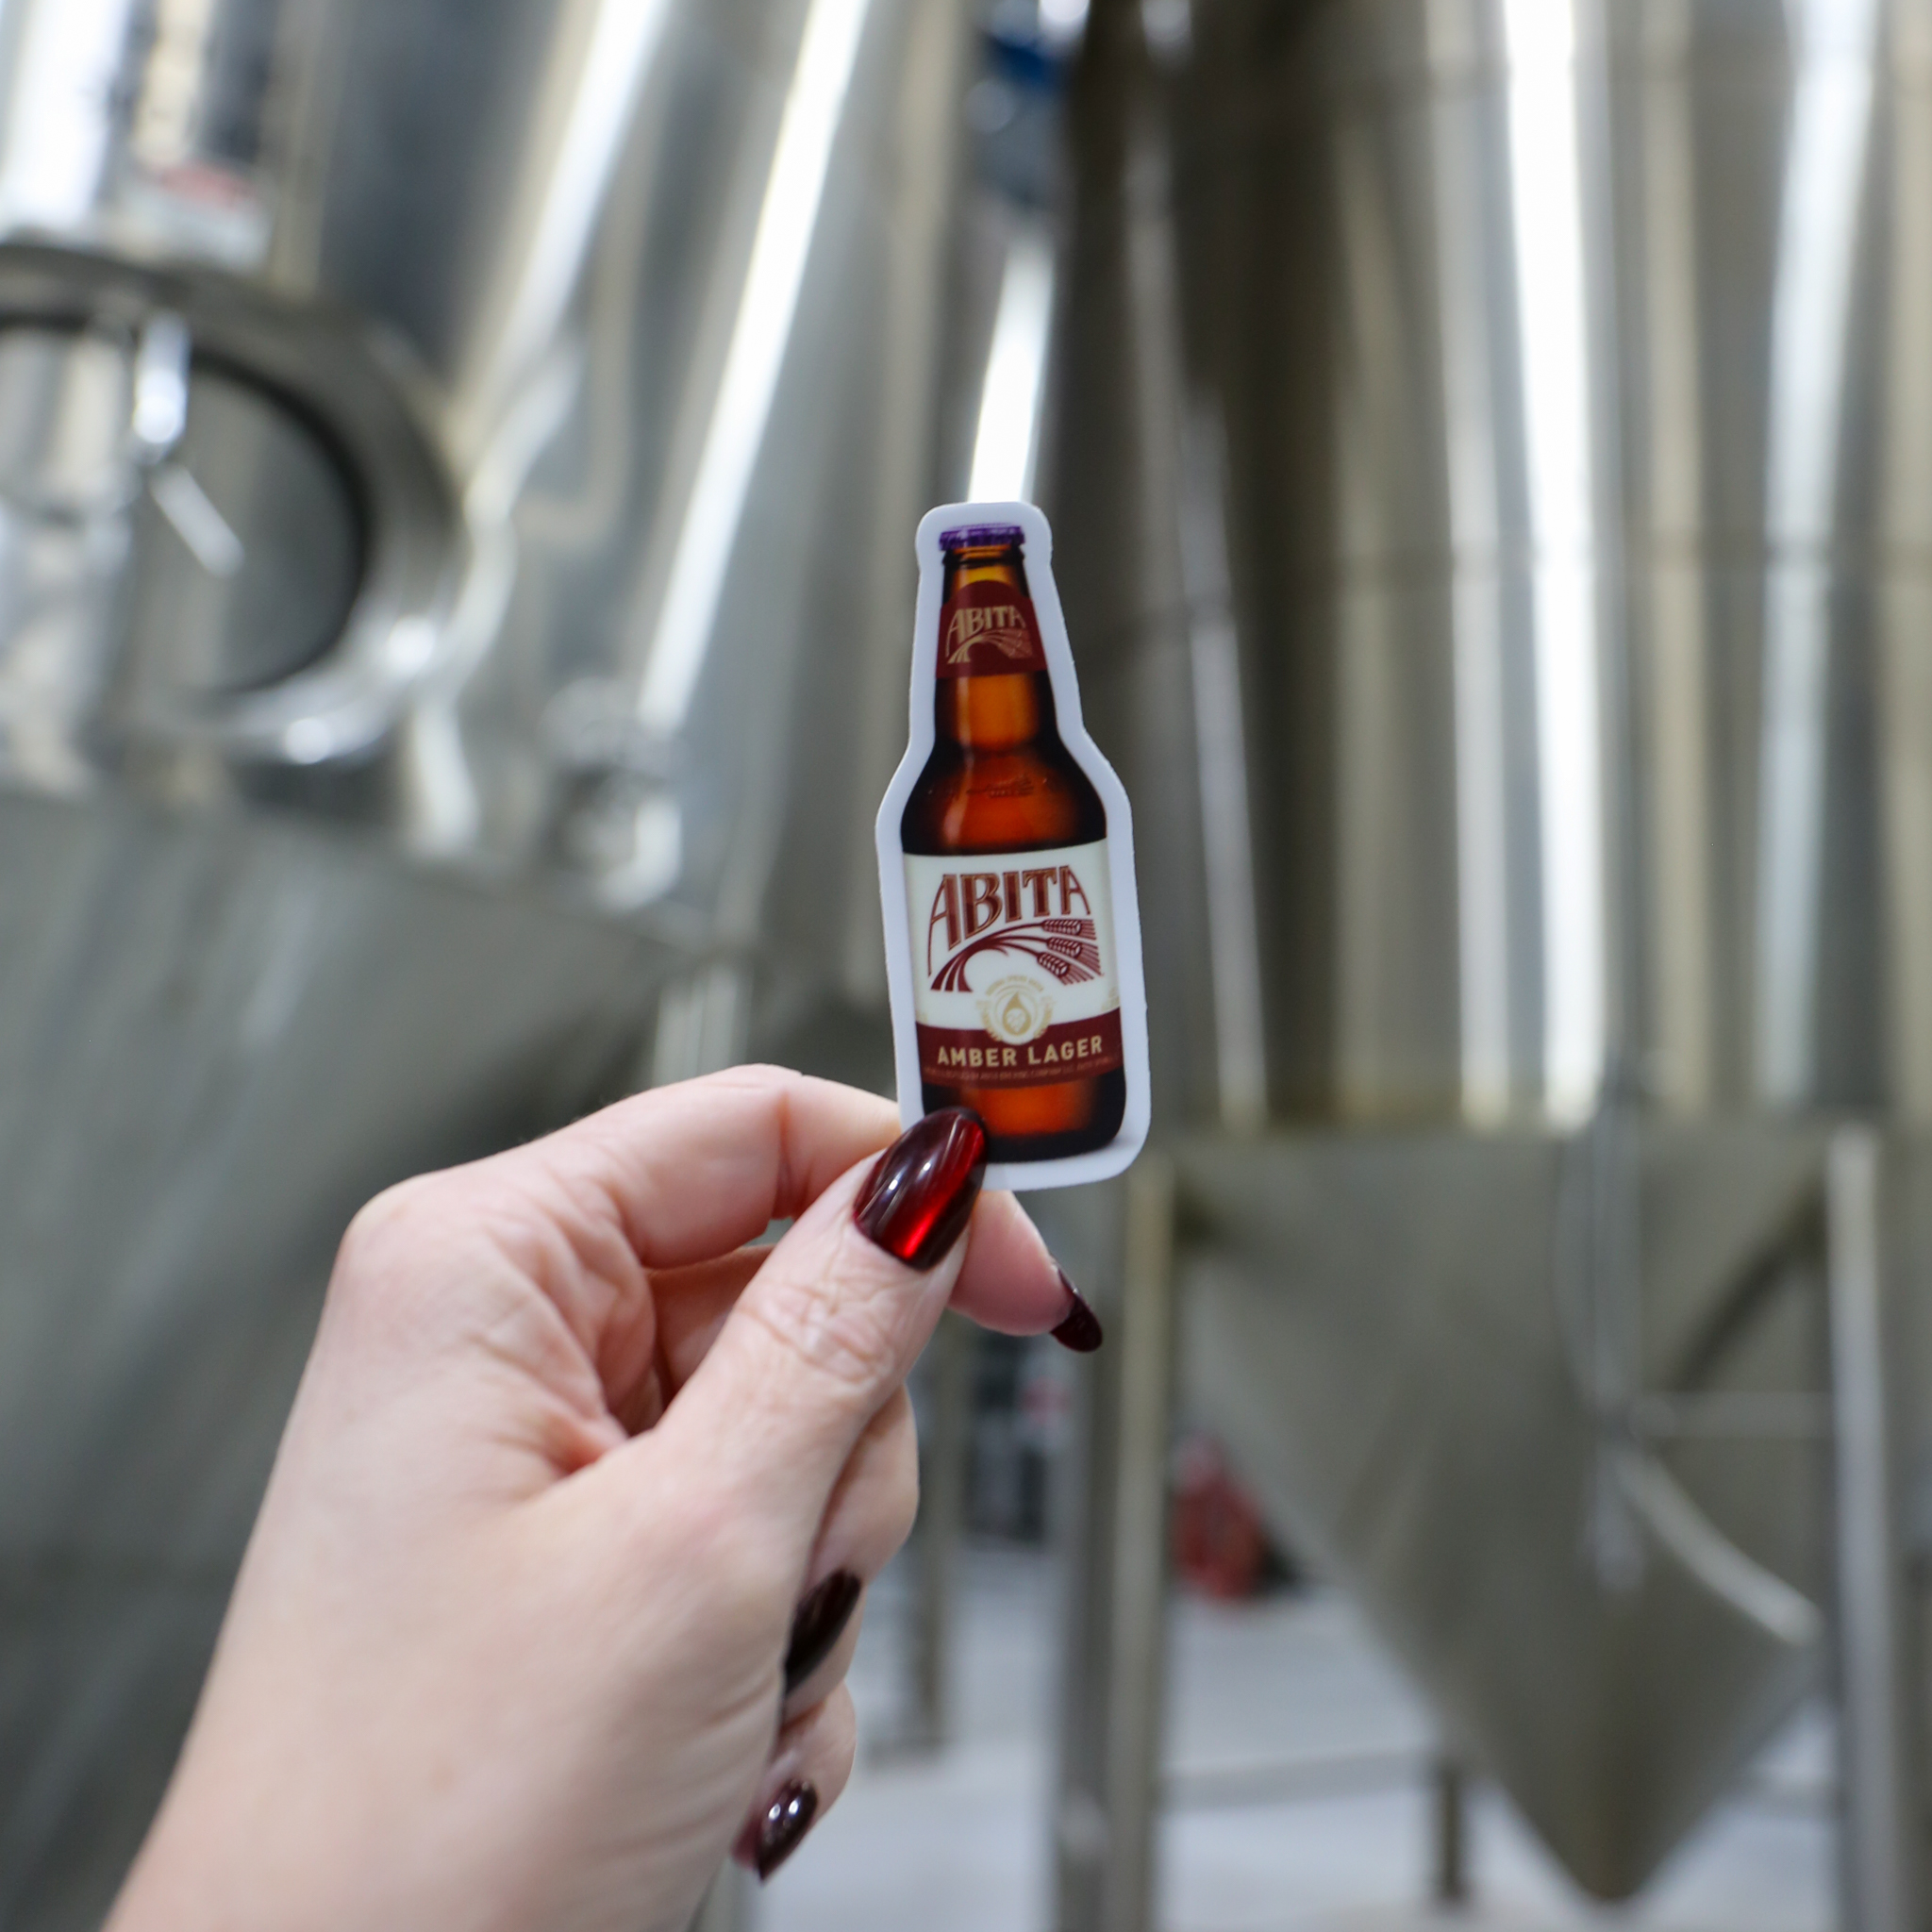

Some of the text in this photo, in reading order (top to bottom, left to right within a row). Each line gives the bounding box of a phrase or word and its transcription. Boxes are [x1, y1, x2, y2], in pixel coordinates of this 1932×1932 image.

[945, 605, 1026, 658] ABITA
[927, 865, 1091, 977] ABITA
[937, 1035, 1102, 1067] AMBER LAGER
